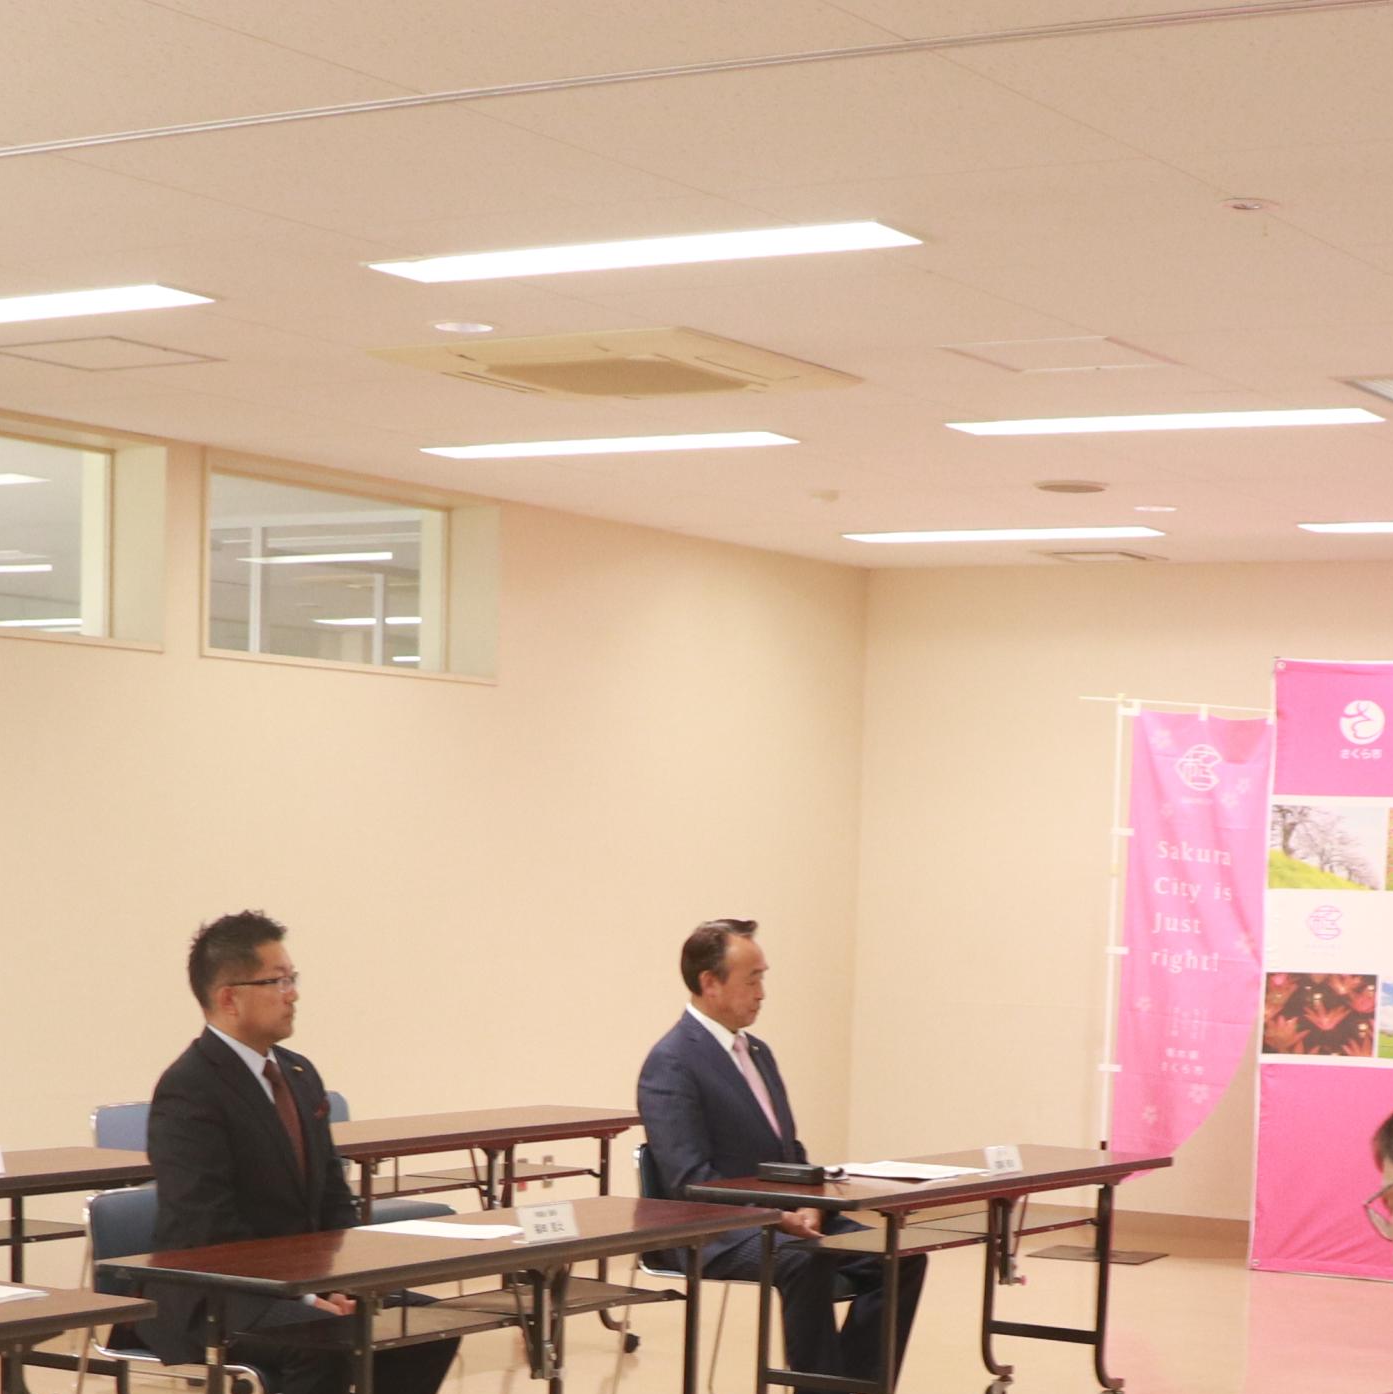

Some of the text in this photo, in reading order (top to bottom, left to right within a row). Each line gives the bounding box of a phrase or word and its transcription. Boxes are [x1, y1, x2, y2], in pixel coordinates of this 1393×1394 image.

[1157, 840, 1231, 867] Sakura
[1154, 876, 1232, 903] City is
[1152, 911, 1201, 935] Just
[1151, 949, 1219, 974] right!
